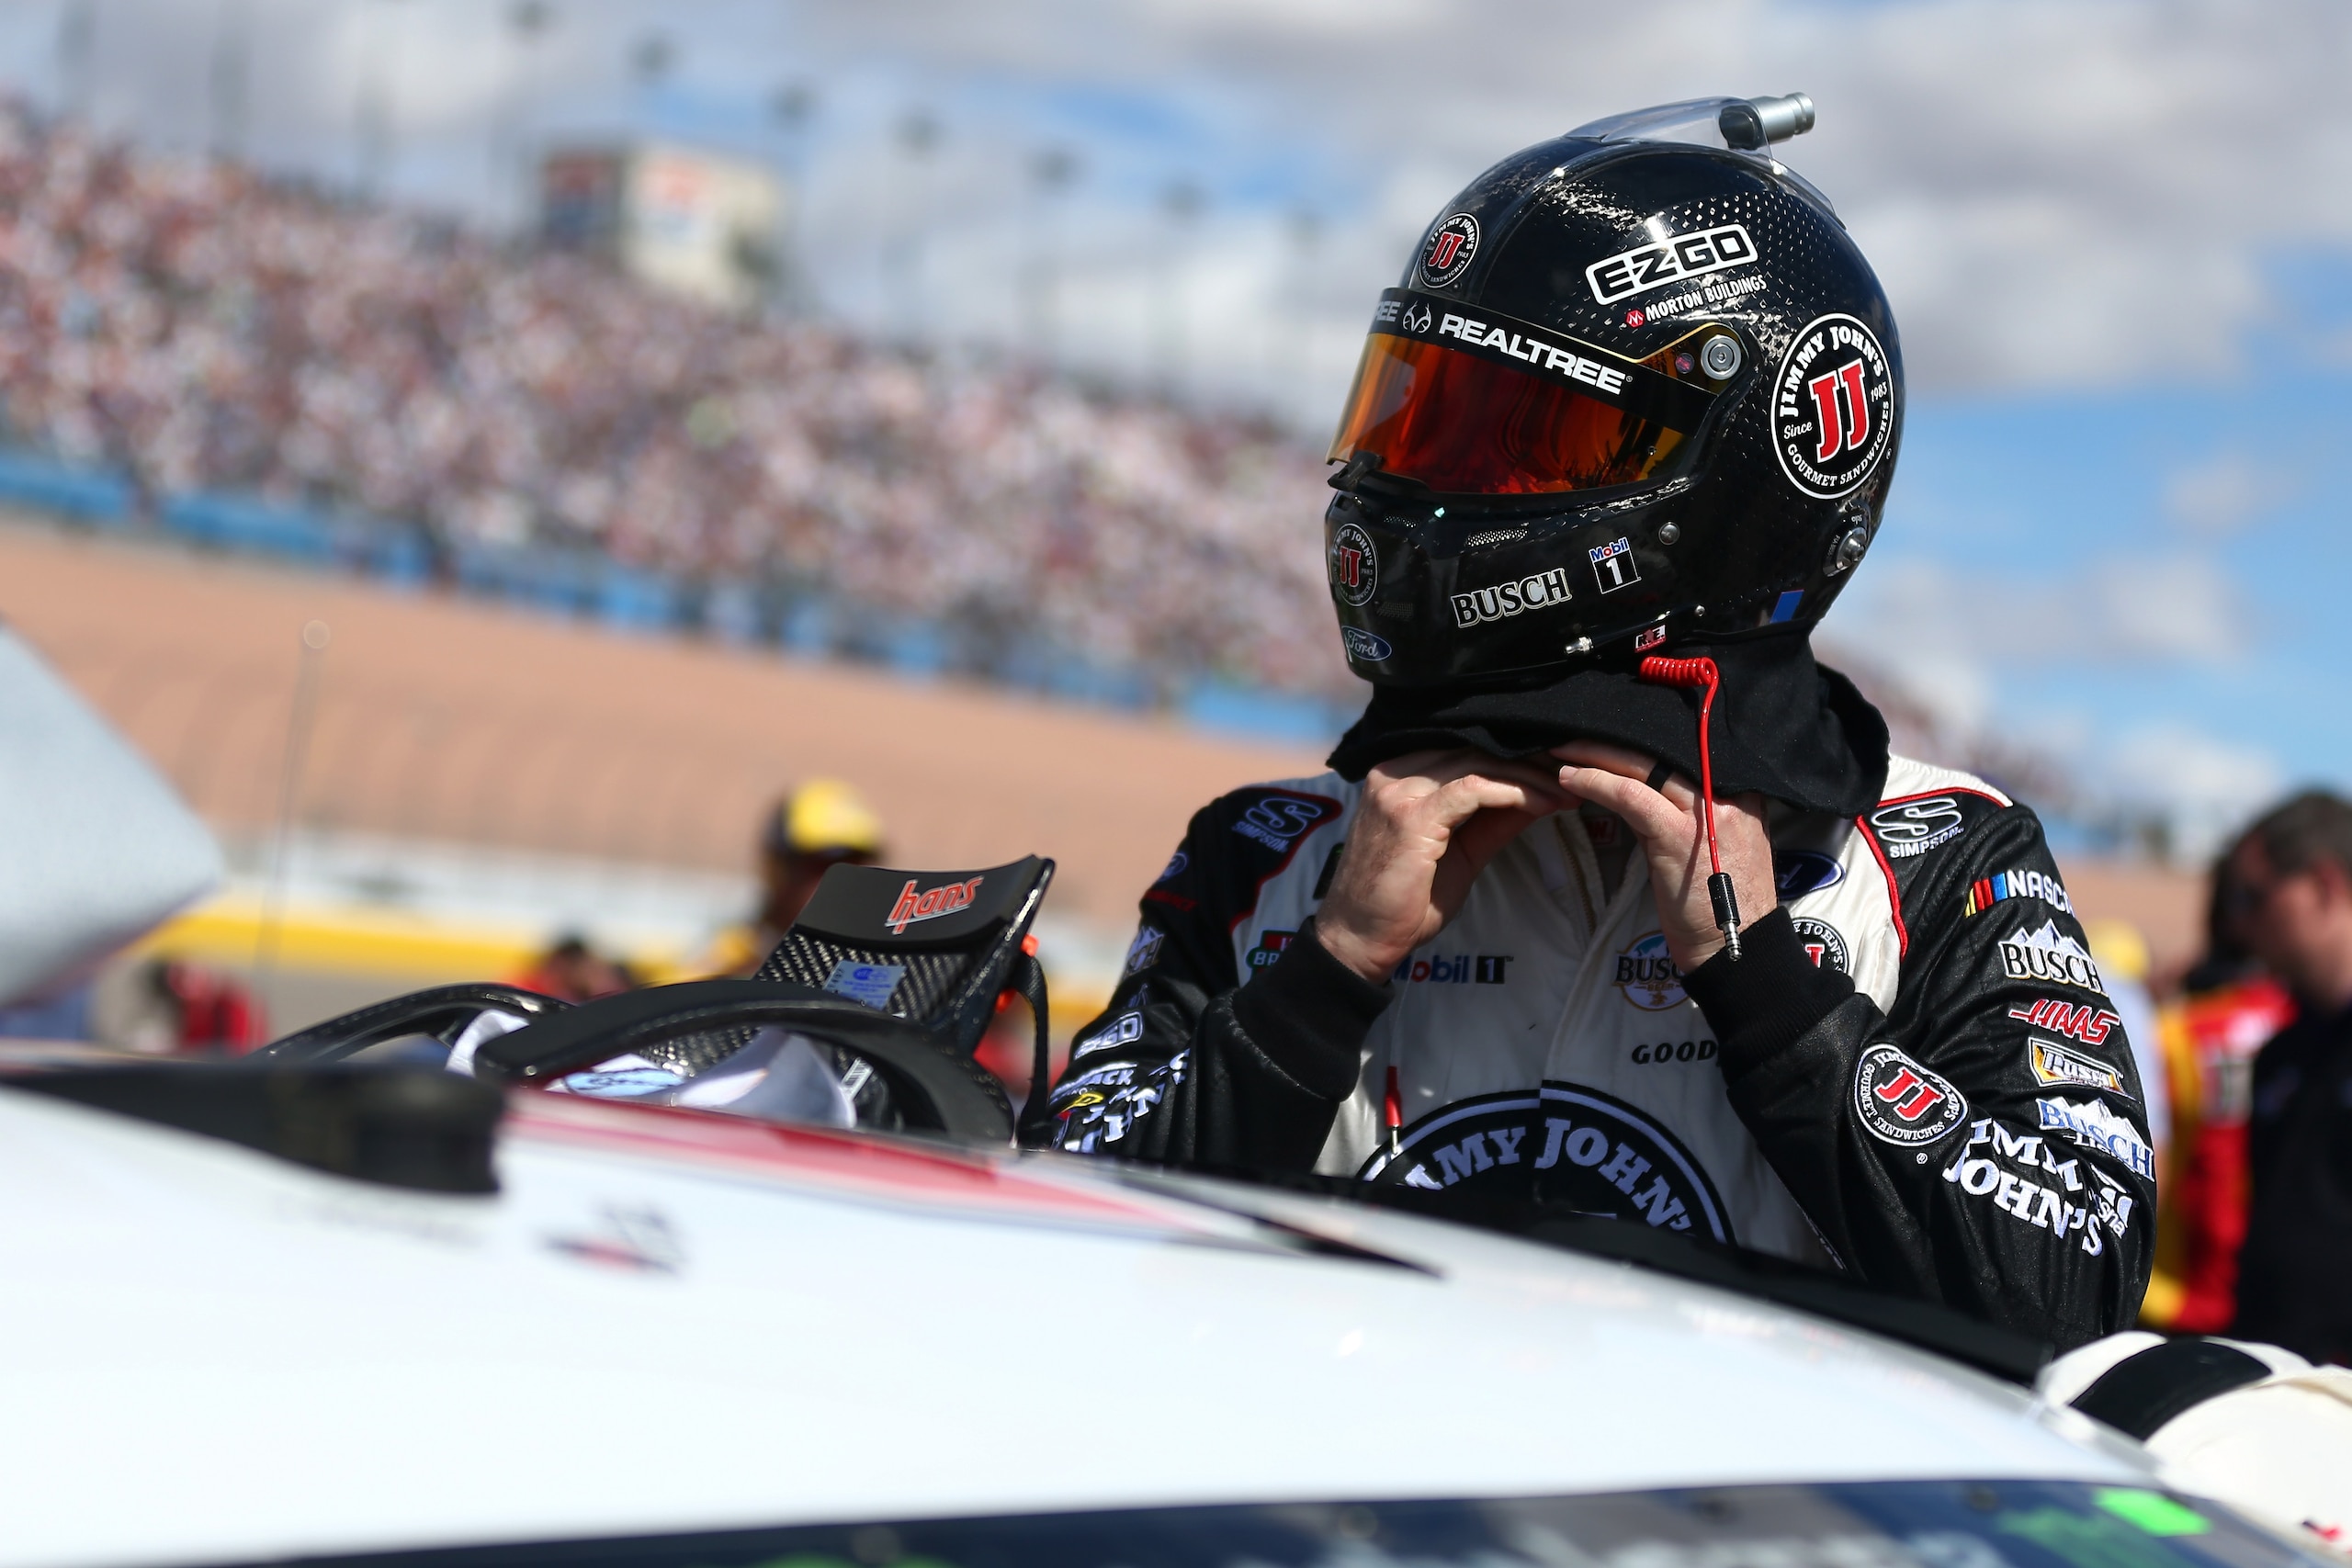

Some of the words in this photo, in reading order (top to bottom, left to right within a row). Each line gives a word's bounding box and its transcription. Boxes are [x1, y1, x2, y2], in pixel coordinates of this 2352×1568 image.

[1428, 231, 1465, 269] JJ
[1593, 231, 1751, 299] EZGO
[1645, 290, 1703, 322] MORTON
[1704, 275, 1768, 303] BUILDINGS
[1439, 313, 1626, 395] REALTREE
[1780, 332, 1826, 417] JIMMY
[1829, 326, 1883, 378] JOHN'S
[1808, 357, 1870, 463] JJ
[1871, 382, 1887, 402] 1983
[1783, 422, 1813, 439] Since
[1788, 444, 1838, 487] GOURMET
[1839, 400, 1889, 484] SANDWICHES
[1589, 537, 1629, 562] Mobil
[1606, 558, 1623, 585] 1
[1451, 569, 1572, 628] BUSCH
[1346, 629, 1379, 658] Ford
[1890, 827, 1960, 859] SIMPSON
[887, 875, 985, 935] hans
[1804, 922, 1844, 964] JOHN'S
[2000, 942, 2107, 996] BUSCH
[2009, 998, 2121, 1045] HAAS
[1632, 1040, 1717, 1066] GOOD
[1860, 1064, 1878, 1119] GOURMET
[1873, 1066, 1946, 1121] JJ
[1873, 1116, 1946, 1140] SANDWICHES
[2039, 1100, 2154, 1182] BUSCH
[1534, 1117, 1692, 1233] JOHN'
[1942, 1142, 2104, 1257] JOHN'S
